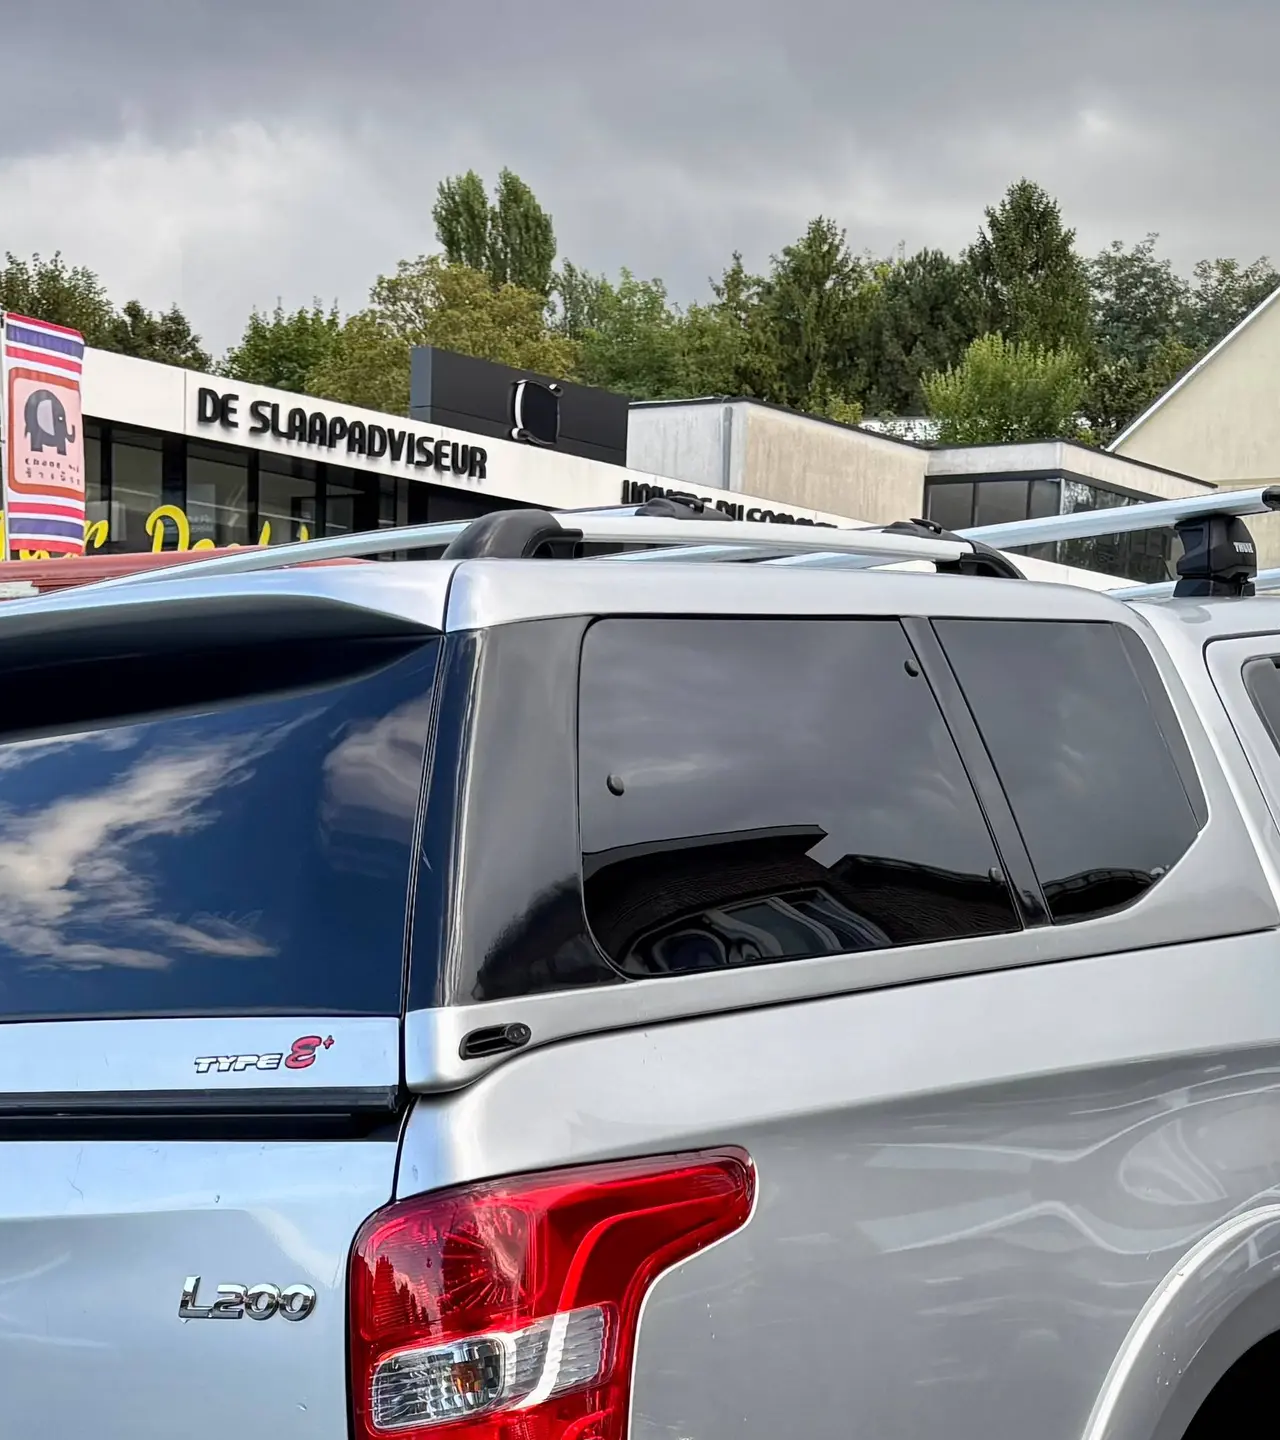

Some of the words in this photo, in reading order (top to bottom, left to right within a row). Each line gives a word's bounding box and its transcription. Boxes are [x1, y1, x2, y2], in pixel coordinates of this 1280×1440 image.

[198, 387, 239, 427] DE
[249, 400, 488, 479] SLAAPADVISEUR
[194, 1053, 283, 1073] TYPE
[179, 1275, 317, 1321] L200
